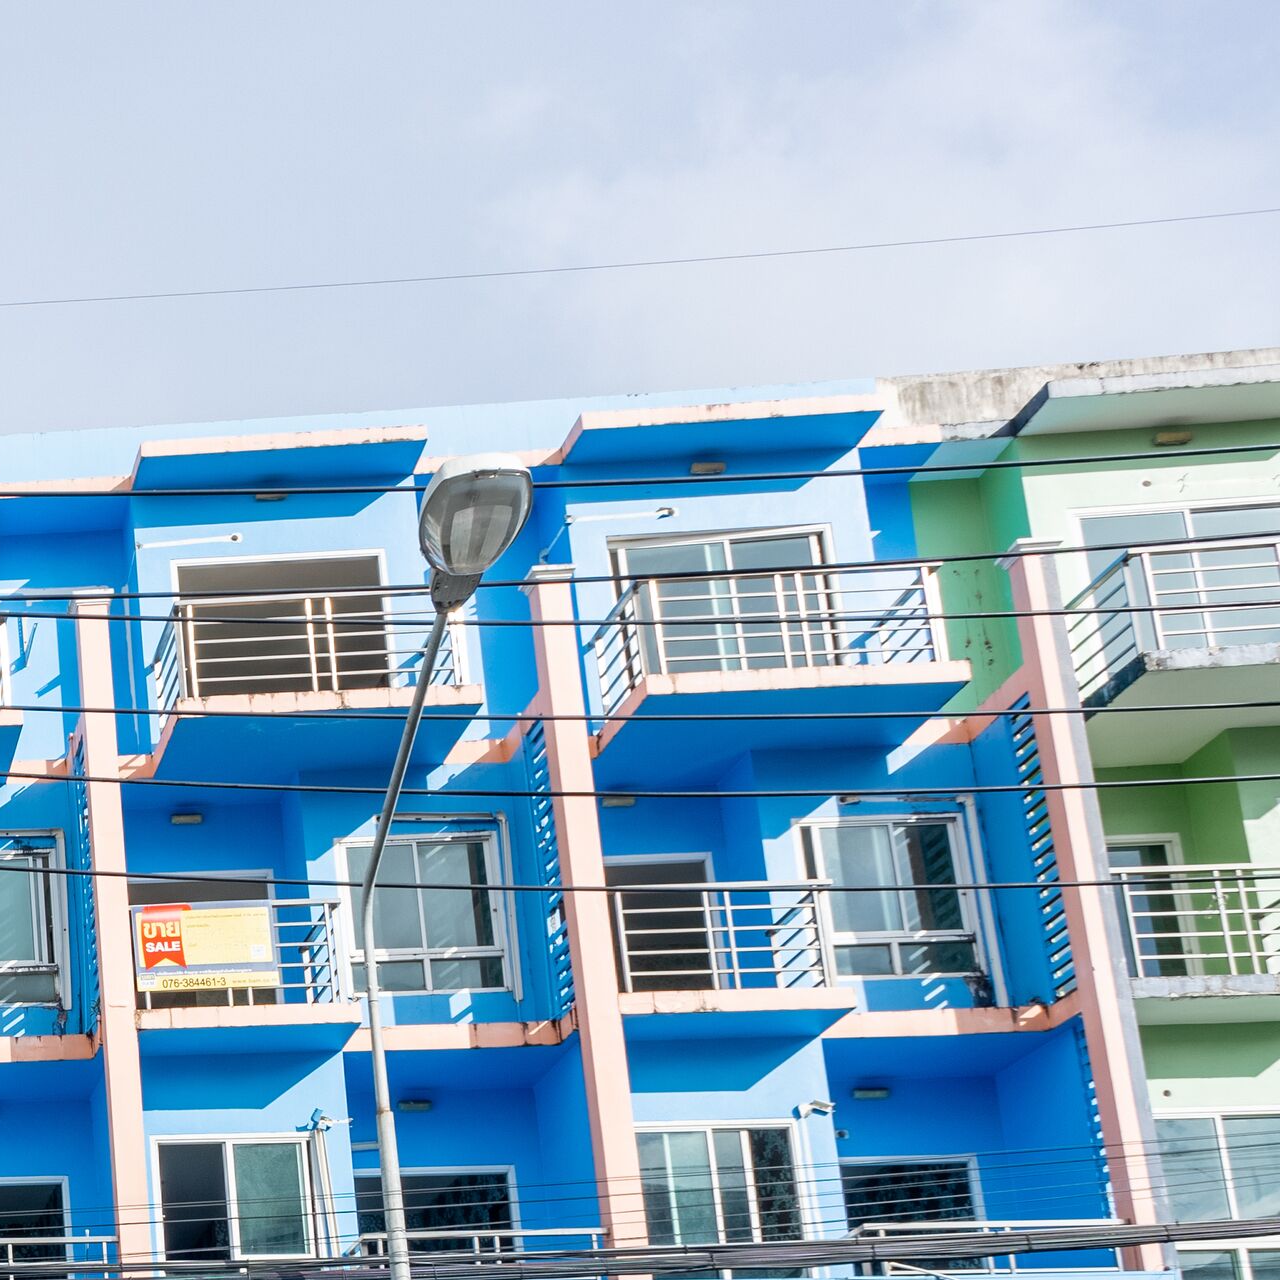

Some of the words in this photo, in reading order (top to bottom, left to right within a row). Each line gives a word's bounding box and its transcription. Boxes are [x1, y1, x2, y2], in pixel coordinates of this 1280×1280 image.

[143, 921, 180, 938] ขาย
[145, 941, 181, 953] SALE
[162, 977, 227, 988] 076-384461-3
